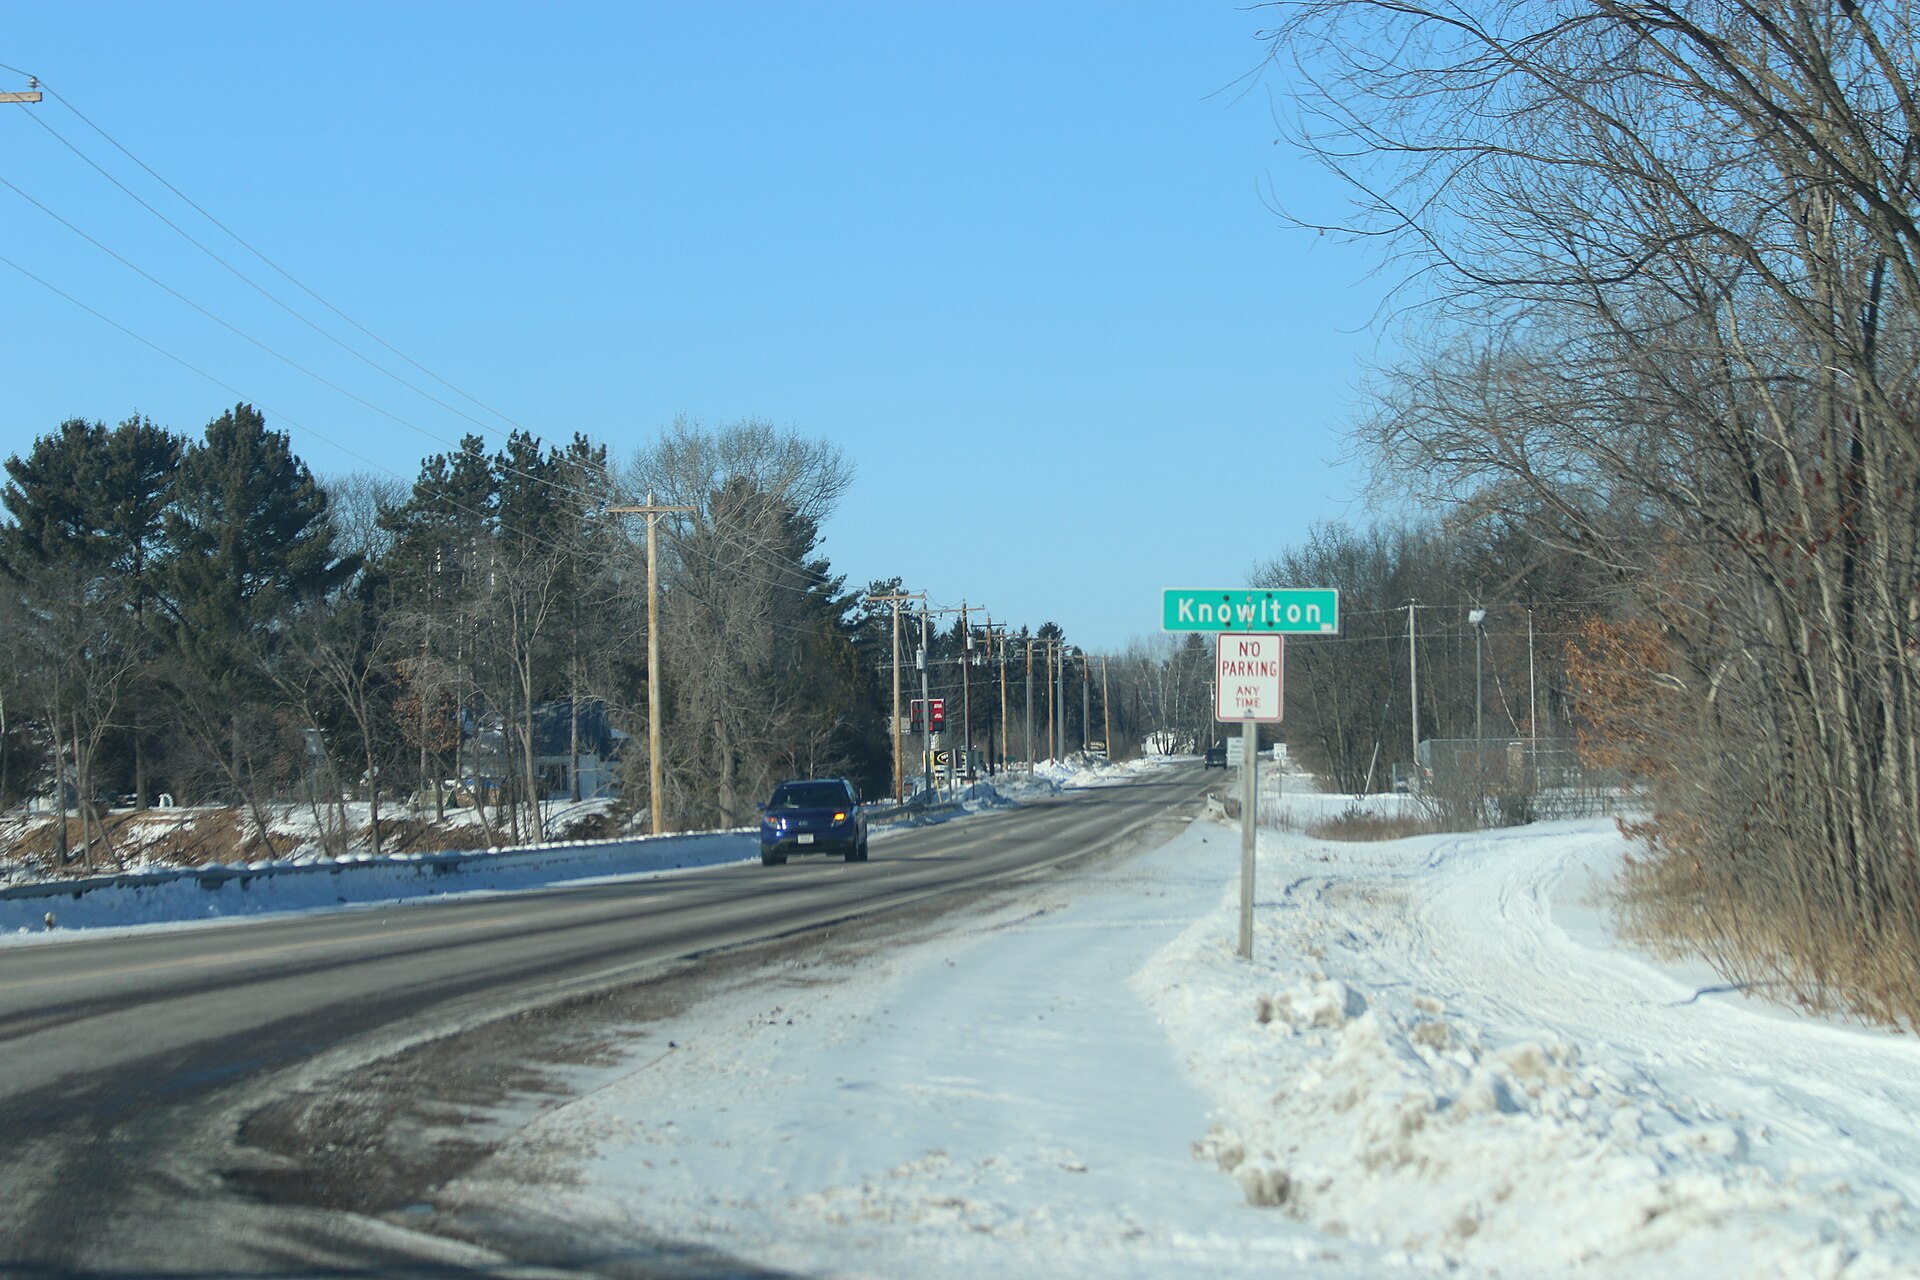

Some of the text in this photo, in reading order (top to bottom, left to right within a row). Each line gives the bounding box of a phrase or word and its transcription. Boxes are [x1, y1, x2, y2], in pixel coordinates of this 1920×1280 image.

[1178, 598, 1321, 623] Knowlton
[1239, 641, 1261, 657] NO
[1222, 661, 1277, 677] PARKING
[1236, 686, 1260, 697] ANY
[1235, 698, 1261, 709] TIME
